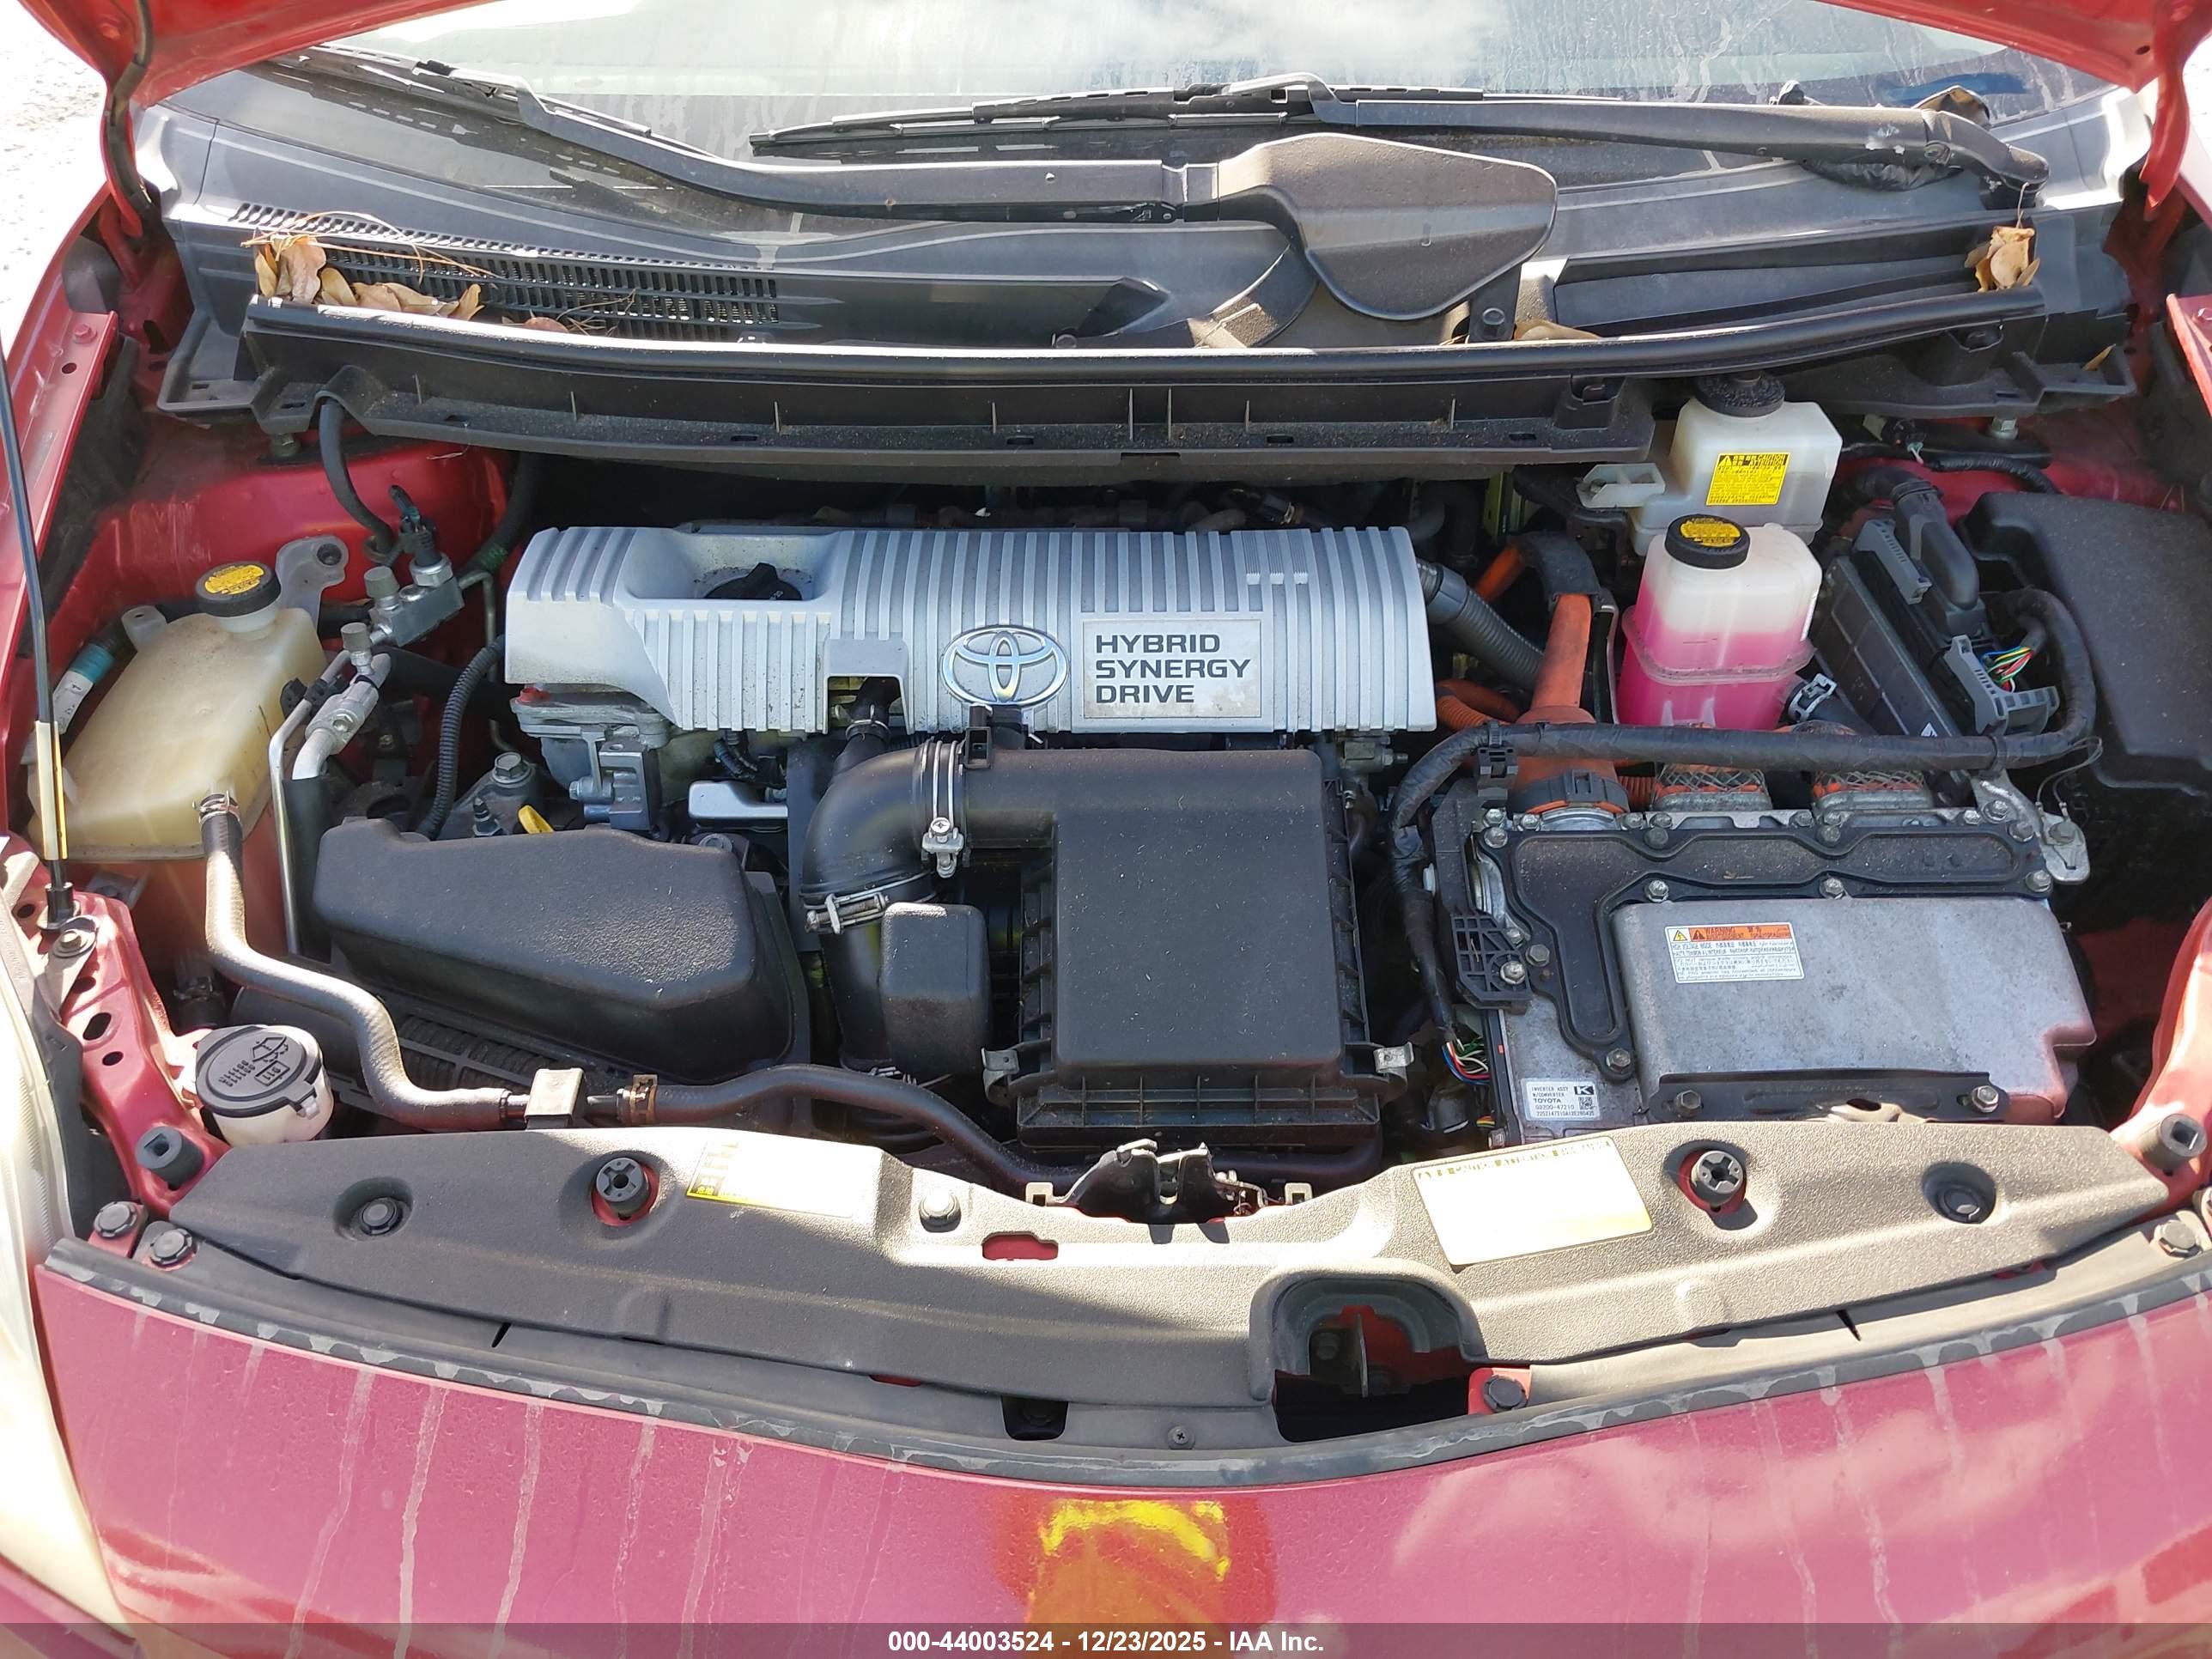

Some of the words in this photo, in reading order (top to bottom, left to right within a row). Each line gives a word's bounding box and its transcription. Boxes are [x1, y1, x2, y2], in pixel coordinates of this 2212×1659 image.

[1096, 634, 1220, 653] HYBRID
[1096, 659, 1251, 678] SYNERGY
[1096, 684, 1194, 703] DRIVE
